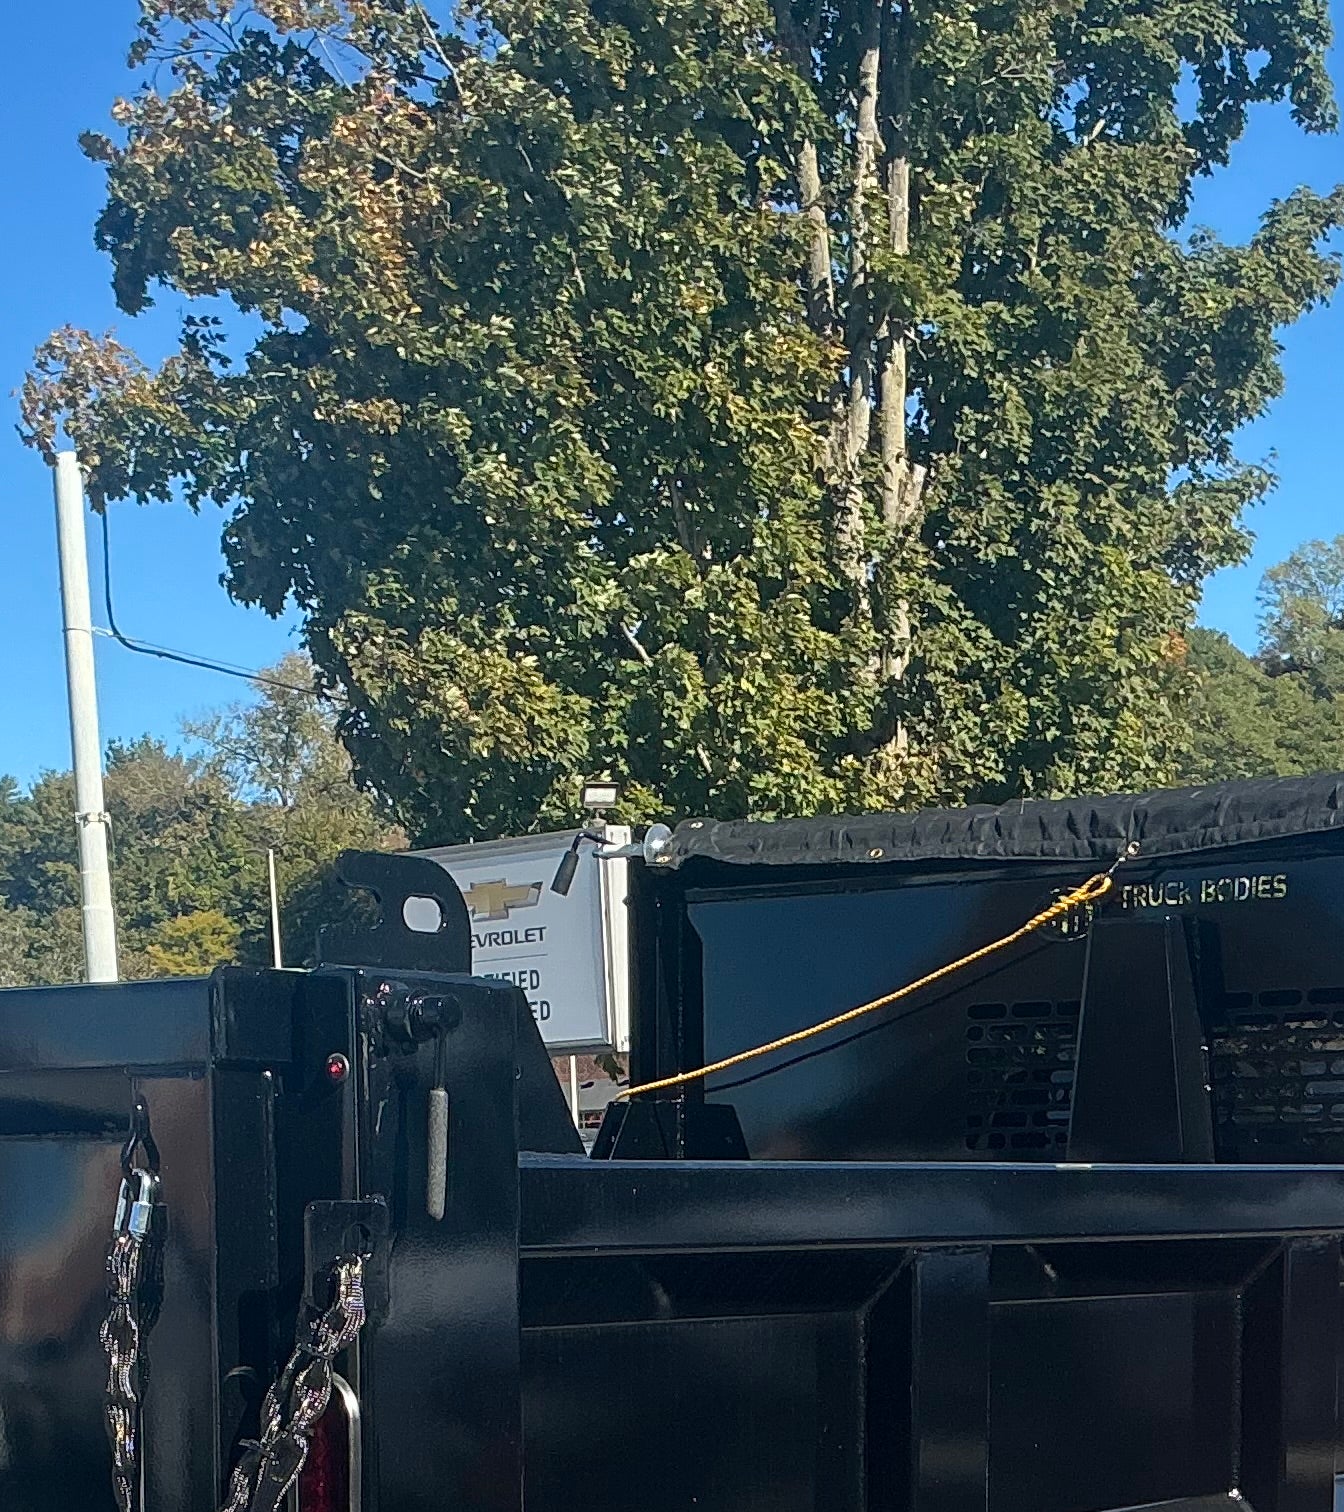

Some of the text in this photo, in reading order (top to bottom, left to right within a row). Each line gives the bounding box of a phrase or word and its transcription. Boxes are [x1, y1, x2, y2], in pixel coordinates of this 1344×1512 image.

[1122, 874, 1287, 909] TRUCK BODIES
[471, 926, 547, 948] EVROLET
